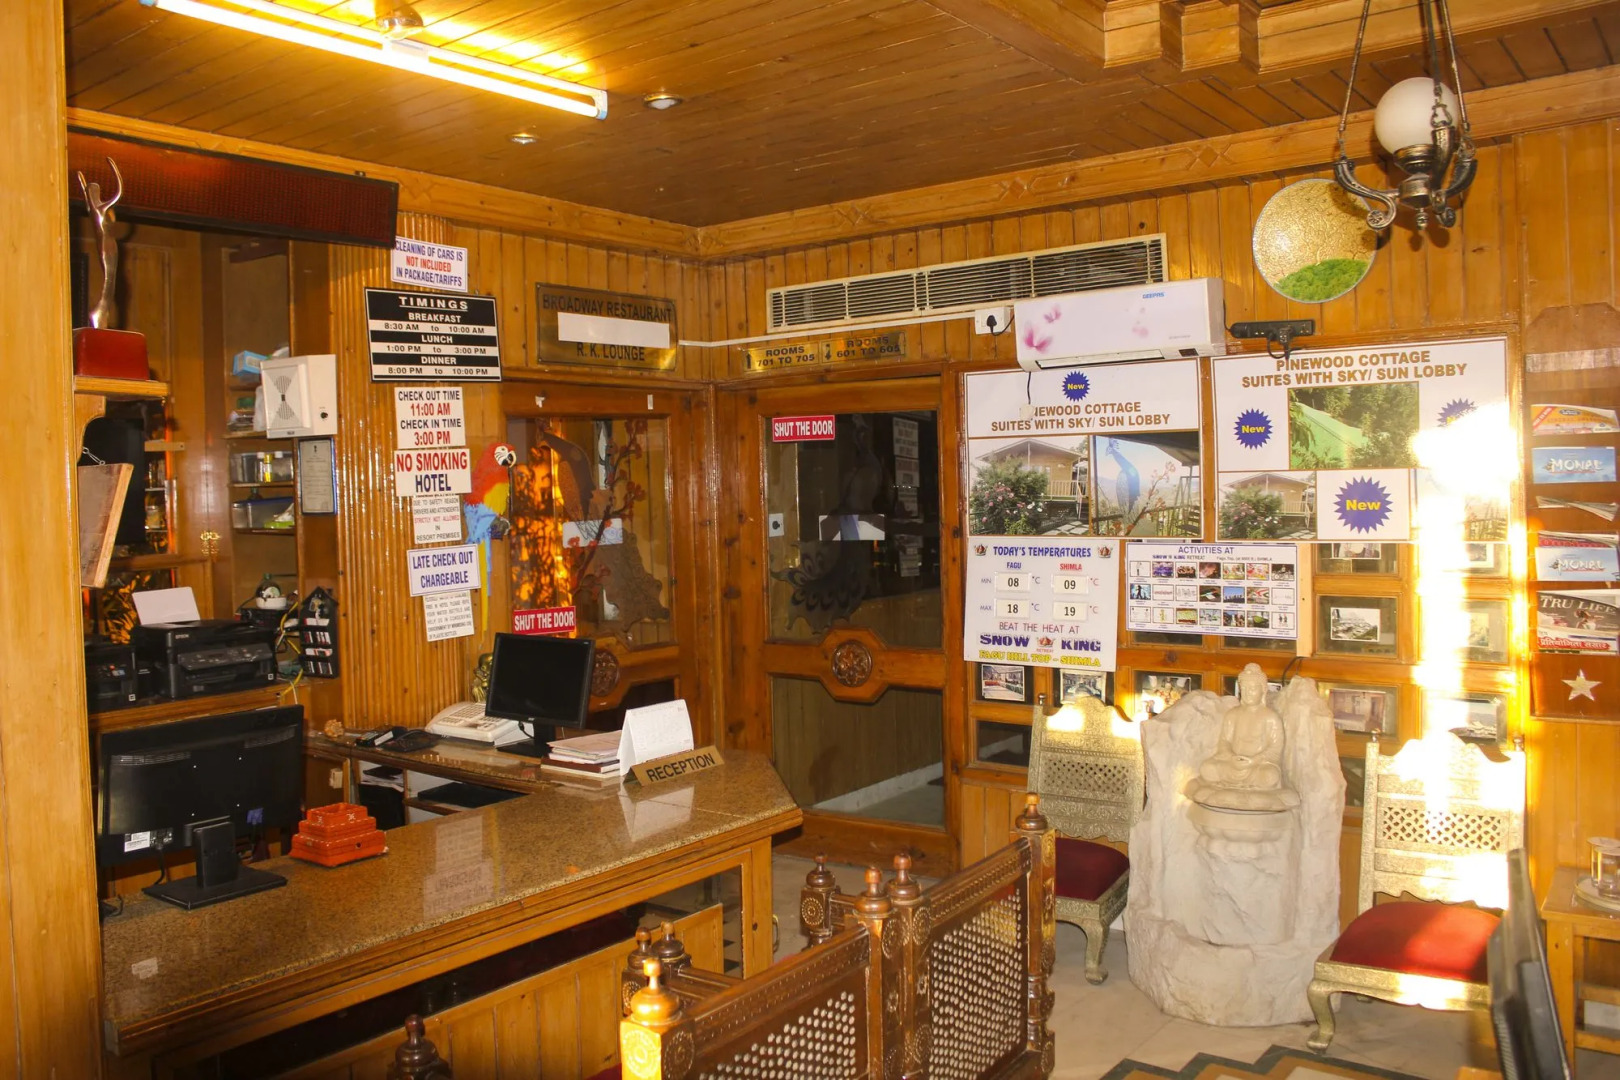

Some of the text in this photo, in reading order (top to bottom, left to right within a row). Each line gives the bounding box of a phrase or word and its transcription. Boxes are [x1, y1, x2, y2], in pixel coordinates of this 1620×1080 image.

[396, 241, 462, 261] CLEANING OF CARS IS
[406, 256, 451, 272] NOT INCLUDED
[396, 267, 462, 286] IN PACKAGE/TARIFFS
[399, 296, 468, 310] TIMINGS
[542, 294, 672, 322] BROADWAY RESTAURANT
[408, 312, 461, 323] BREAKFAST
[421, 335, 453, 343] LUNCH
[847, 337, 889, 348] ROOMS
[577, 342, 645, 361] R. K. LOUNGE
[765, 346, 805, 357] ROOMS
[837, 350, 856, 358] 601
[757, 358, 774, 367] 701
[796, 354, 815, 363] 705
[1276, 351, 1430, 371] PINEWOOD COTTAGE
[1242, 374, 1291, 388] SUITES
[1296, 371, 1332, 384] WITH
[1376, 367, 1409, 380] SUN
[1414, 364, 1467, 379] LOBBY
[398, 391, 460, 401] CHECK OUT TIME
[410, 403, 450, 416] 11:00 AM
[1085, 402, 1141, 414] COTTAGE
[400, 418, 461, 429] CHECK IN TIME
[774, 420, 833, 437] SHUT THE DOOR
[991, 420, 1031, 432] SUITES
[1035, 418, 1065, 430] WITH
[1099, 416, 1124, 427] SUN
[1128, 414, 1170, 426] LOBBY
[1242, 424, 1265, 434] New
[414, 431, 450, 446] 3:00 PM
[396, 452, 467, 472] NO SMOKING
[415, 474, 451, 492] HOTEL
[1346, 499, 1381, 511] New
[993, 546, 1091, 558] TODAY'S TEMPERATURES
[413, 551, 473, 569] LATE CHECK OUT
[421, 571, 468, 588] CHARGEABLE
[1008, 578, 1019, 587] 08
[1064, 580, 1076, 590] 09
[1007, 604, 1018, 613] 18
[1064, 606, 1076, 616] 19
[1540, 595, 1616, 614] TRU LIFE
[514, 611, 574, 631] SHUT THE DOOR
[999, 622, 1080, 634] BEAT THE HEAT AT
[980, 634, 1030, 647] SNOW
[1061, 638, 1100, 651] KING
[979, 650, 1005, 660] FAGU
[1007, 651, 1030, 661] HILL
[1031, 654, 1051, 663] TOP
[1060, 656, 1101, 667] SHIMLA
[646, 752, 716, 782] RECEPTION
